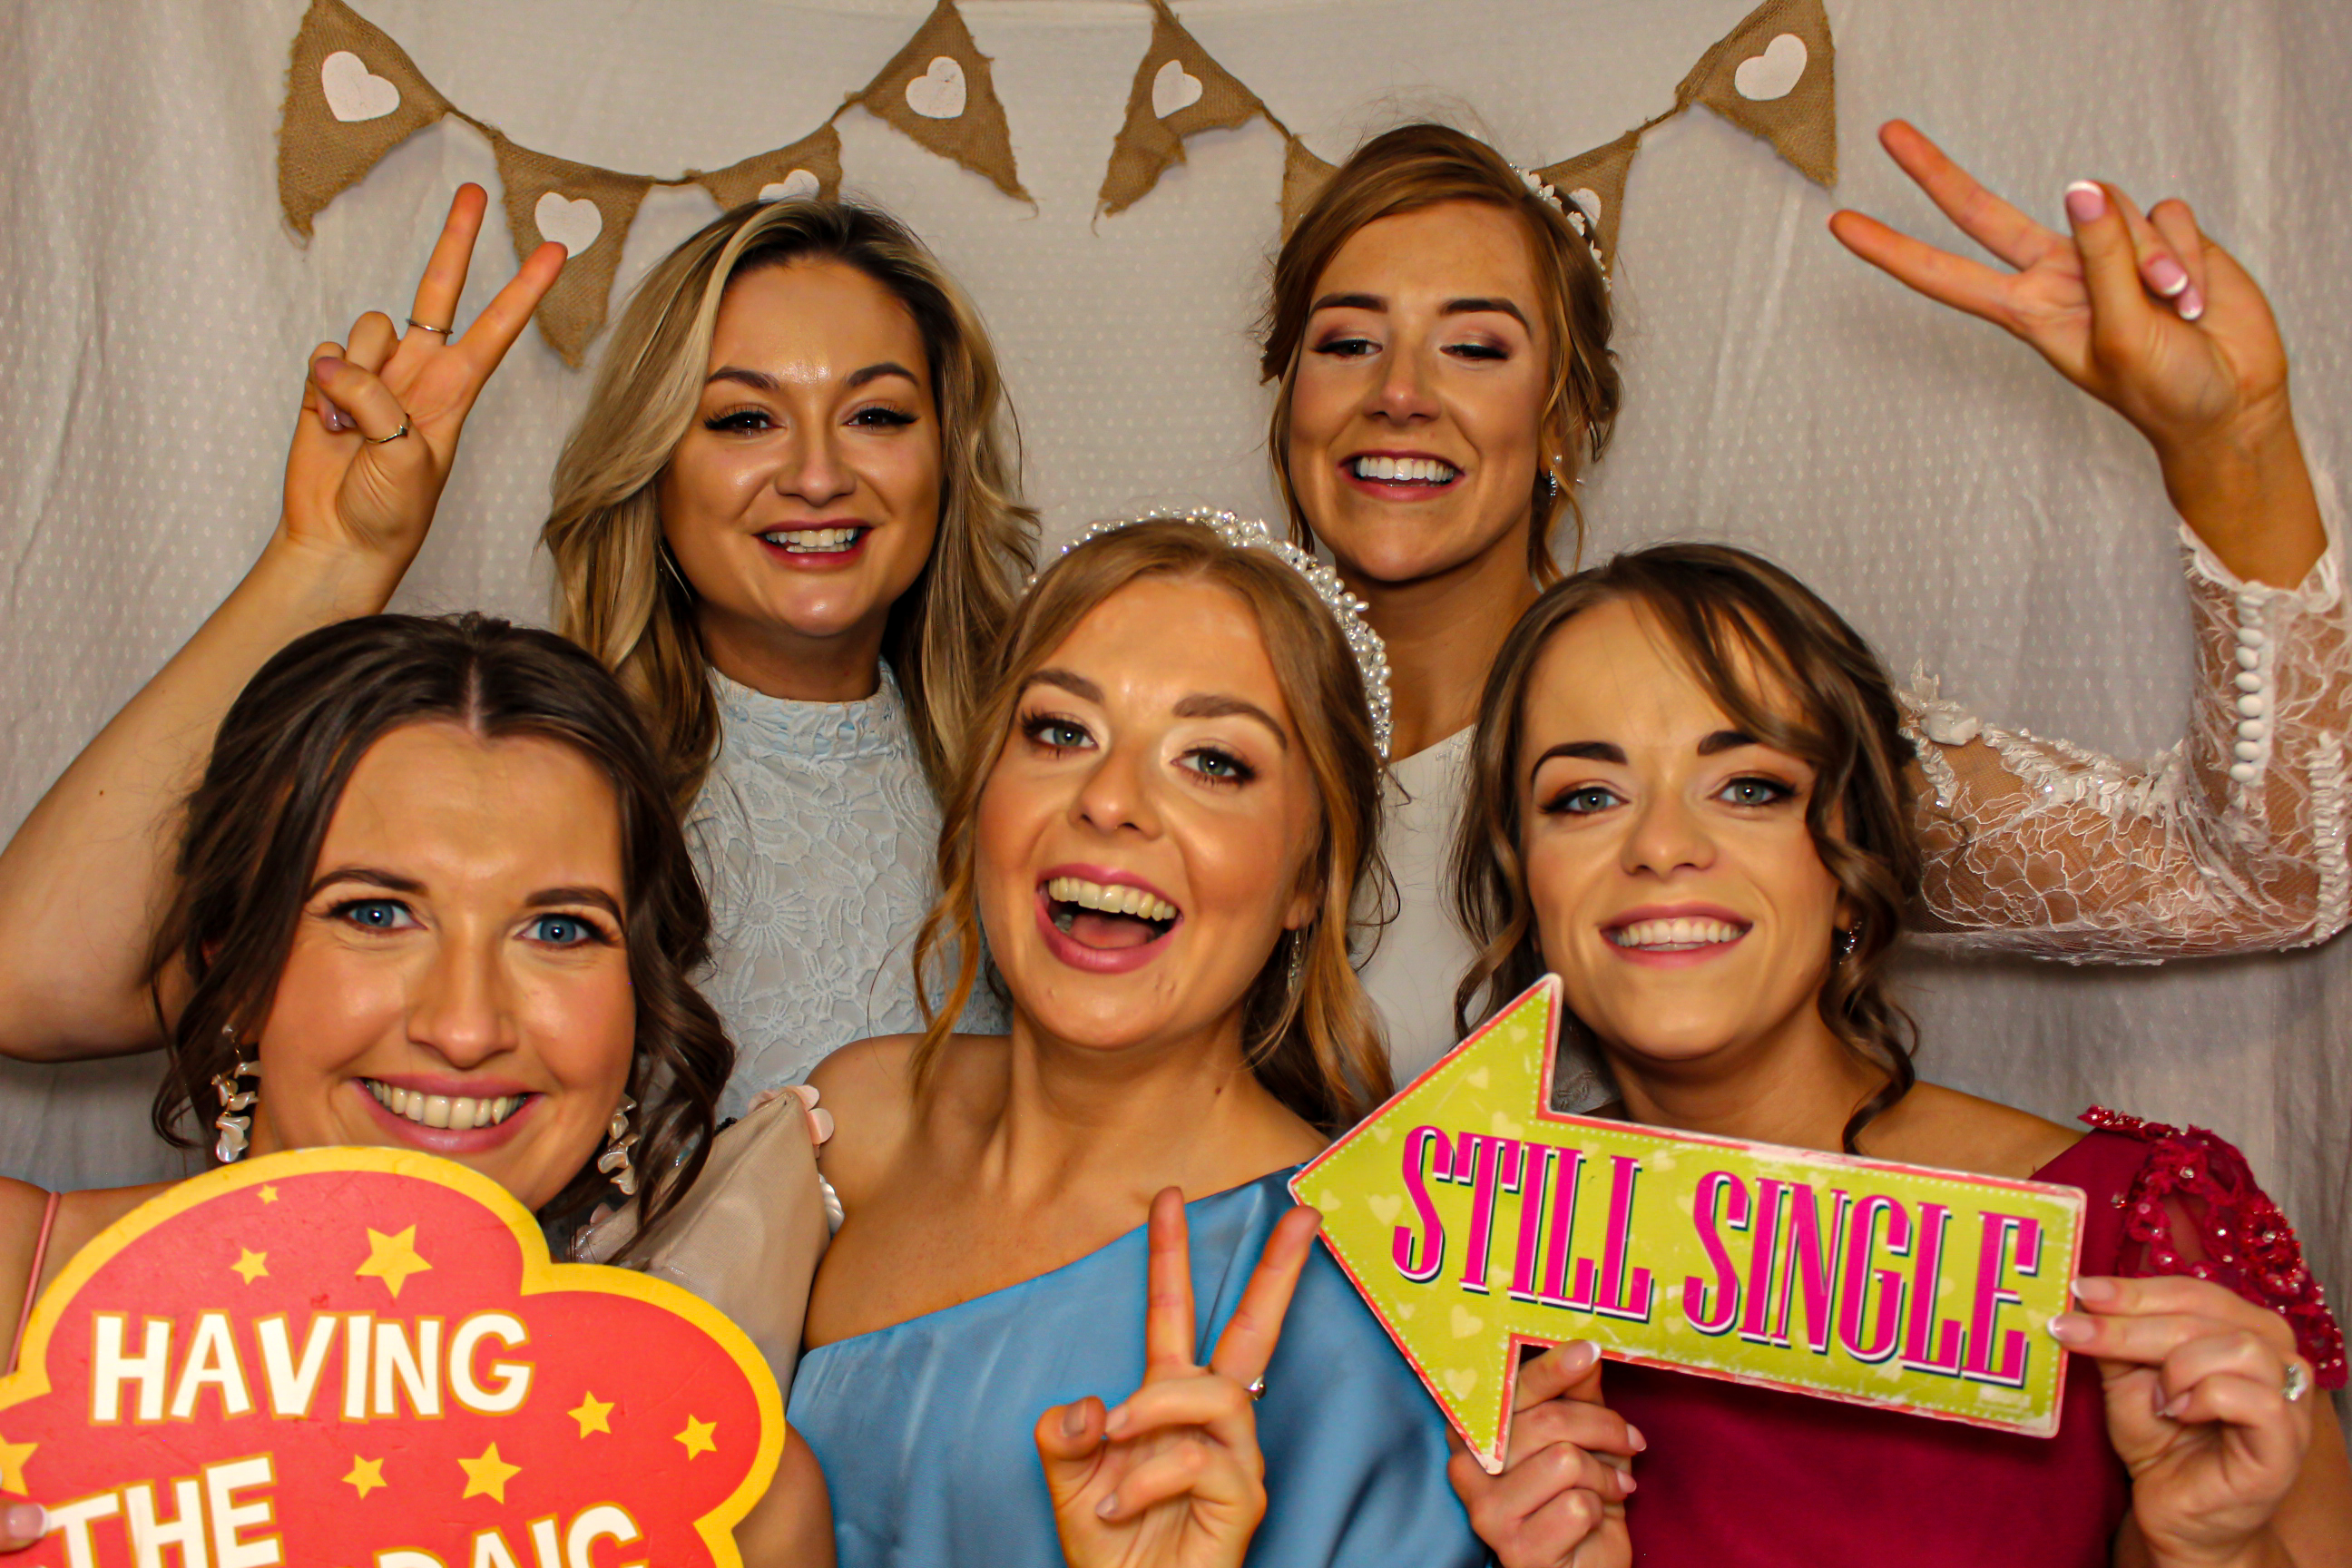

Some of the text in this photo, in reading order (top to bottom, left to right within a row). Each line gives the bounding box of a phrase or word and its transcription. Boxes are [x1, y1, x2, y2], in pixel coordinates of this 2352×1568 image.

[1392, 1124, 2043, 1387] STILL SINGLE
[90, 1309, 534, 1425] HAVING
[45, 1452, 284, 1568] THE
